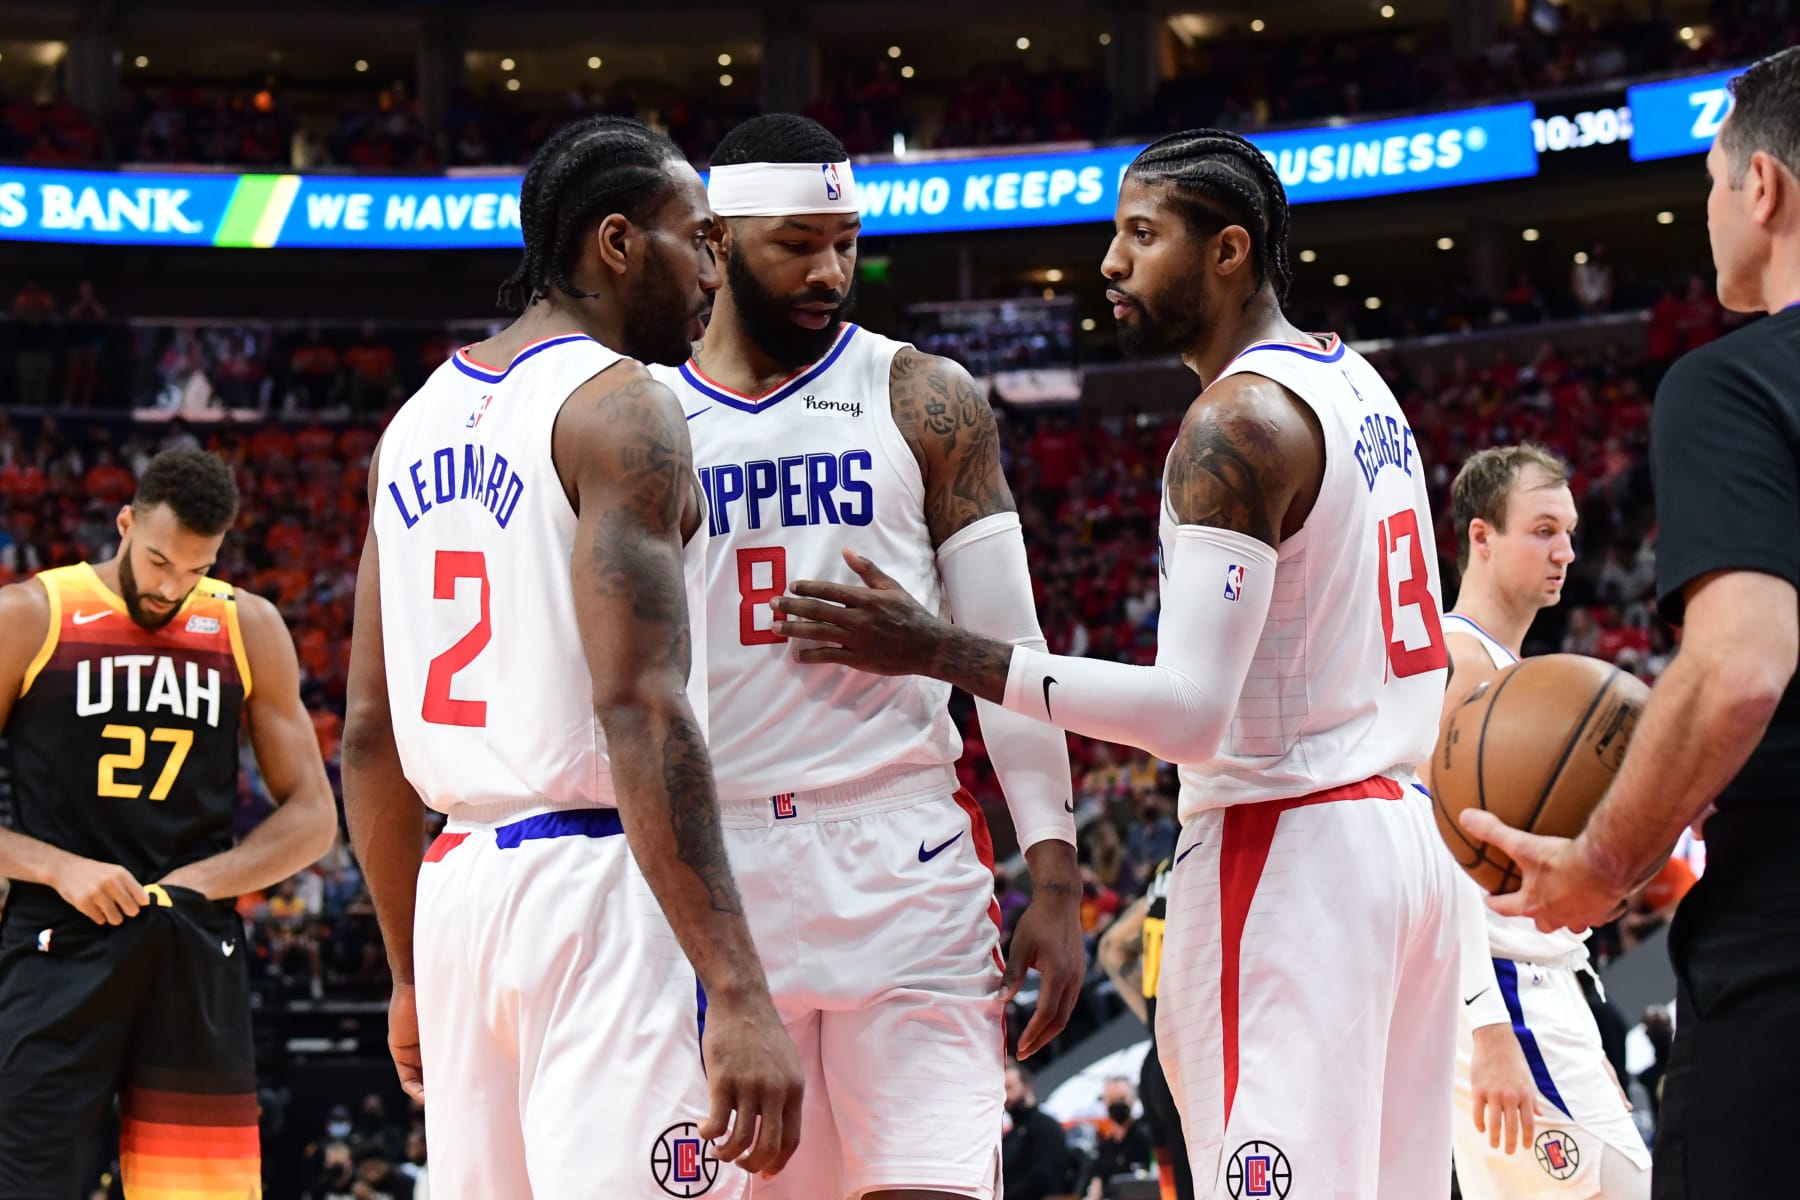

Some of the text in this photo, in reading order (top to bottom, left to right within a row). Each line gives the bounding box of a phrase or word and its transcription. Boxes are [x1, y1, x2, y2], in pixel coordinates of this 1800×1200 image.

[40, 183, 204, 234] BANK
[306, 193, 373, 230] WE
[856, 177, 951, 217] WHO
[963, 166, 1104, 212] KEEPS
[802, 394, 864, 418] honey
[388, 443, 524, 530] LEONARD
[1354, 412, 1413, 493] GEORGE
[736, 546, 788, 646] 8
[1378, 508, 1448, 684] 13
[421, 549, 492, 728] 2
[76, 654, 220, 728] UTAH
[97, 724, 194, 801] 27
